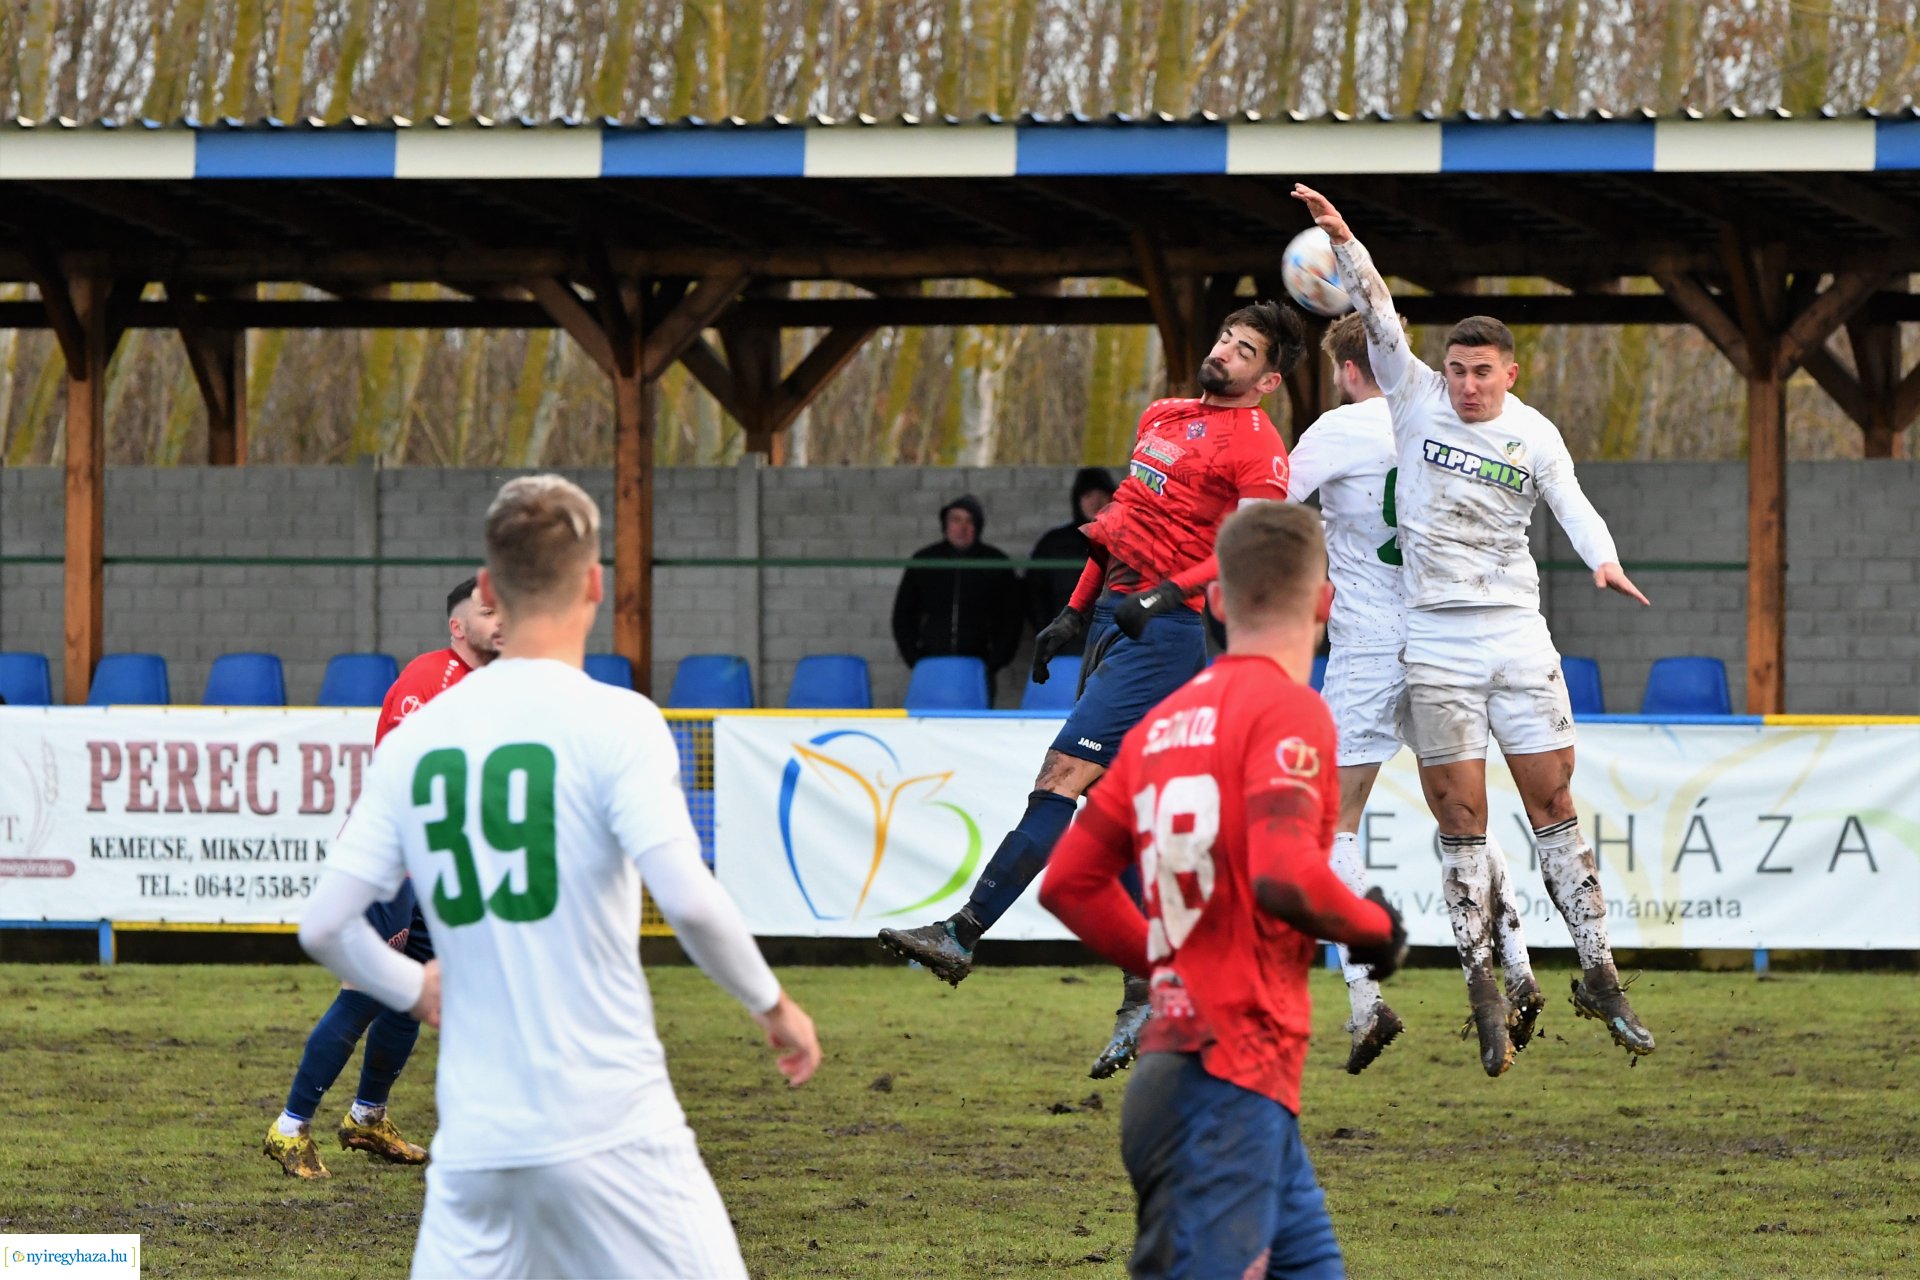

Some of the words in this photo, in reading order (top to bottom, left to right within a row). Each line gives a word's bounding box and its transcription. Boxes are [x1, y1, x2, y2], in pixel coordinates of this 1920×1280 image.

[1077, 737, 1102, 751] JAKO
[86, 741, 279, 815] PEREC
[90, 836, 193, 862] KEMECSE,
[201, 833, 308, 862] MIKSZÁTH
[412, 743, 559, 928] 39
[138, 873, 189, 898] TEL.:
